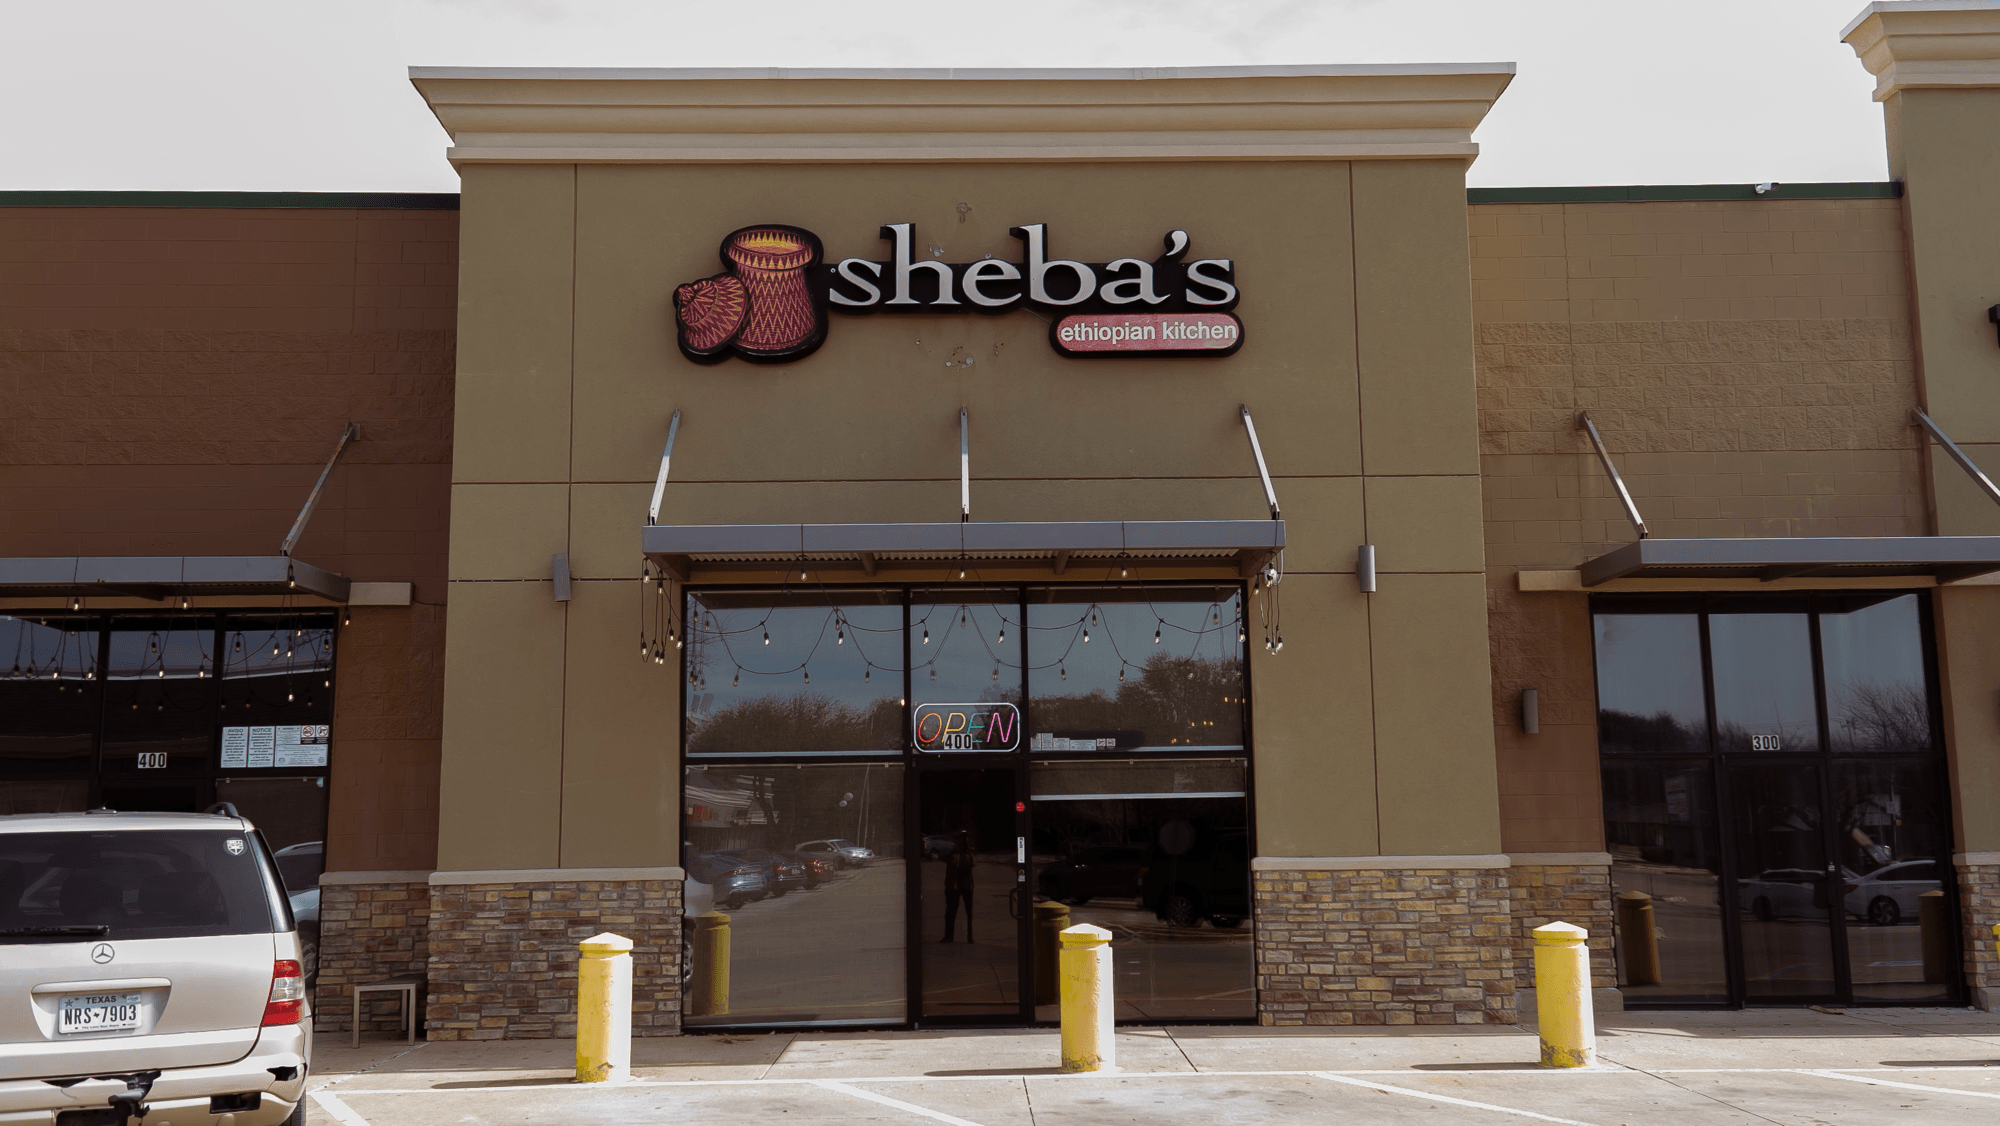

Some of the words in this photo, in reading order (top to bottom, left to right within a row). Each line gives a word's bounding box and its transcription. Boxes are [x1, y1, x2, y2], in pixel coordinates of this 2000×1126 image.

[829, 223, 1236, 307] sheba's
[1060, 322, 1156, 344] ethiopian
[1162, 321, 1237, 340] kitchen
[917, 712, 1015, 743] OPEN
[944, 734, 972, 749] 400
[1753, 735, 1779, 750] 300
[138, 753, 166, 768] 400
[85, 995, 117, 1004] TEXAS
